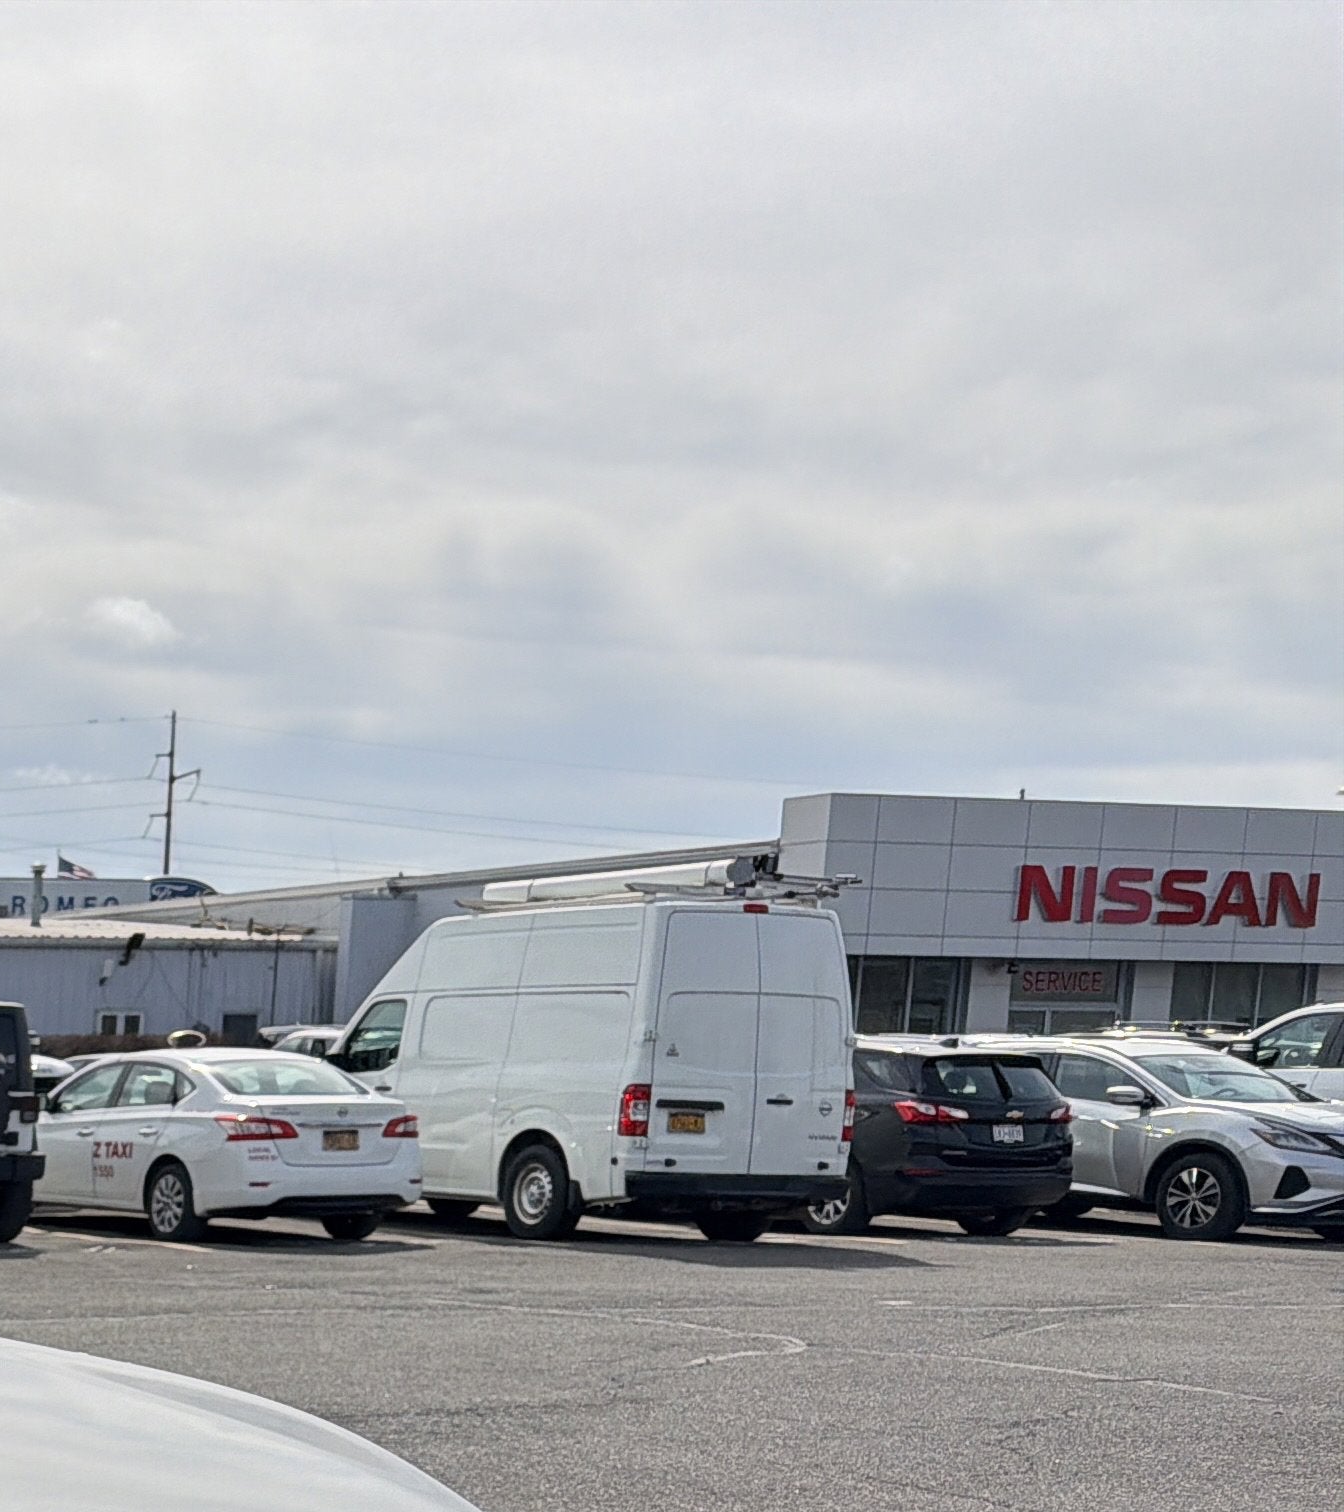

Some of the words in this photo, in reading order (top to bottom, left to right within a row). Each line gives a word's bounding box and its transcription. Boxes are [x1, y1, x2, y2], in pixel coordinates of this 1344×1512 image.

[1016, 865, 1320, 928] NISSAN
[1022, 970, 1103, 992] SERVICE
[104, 1141, 133, 1158] TAXI
